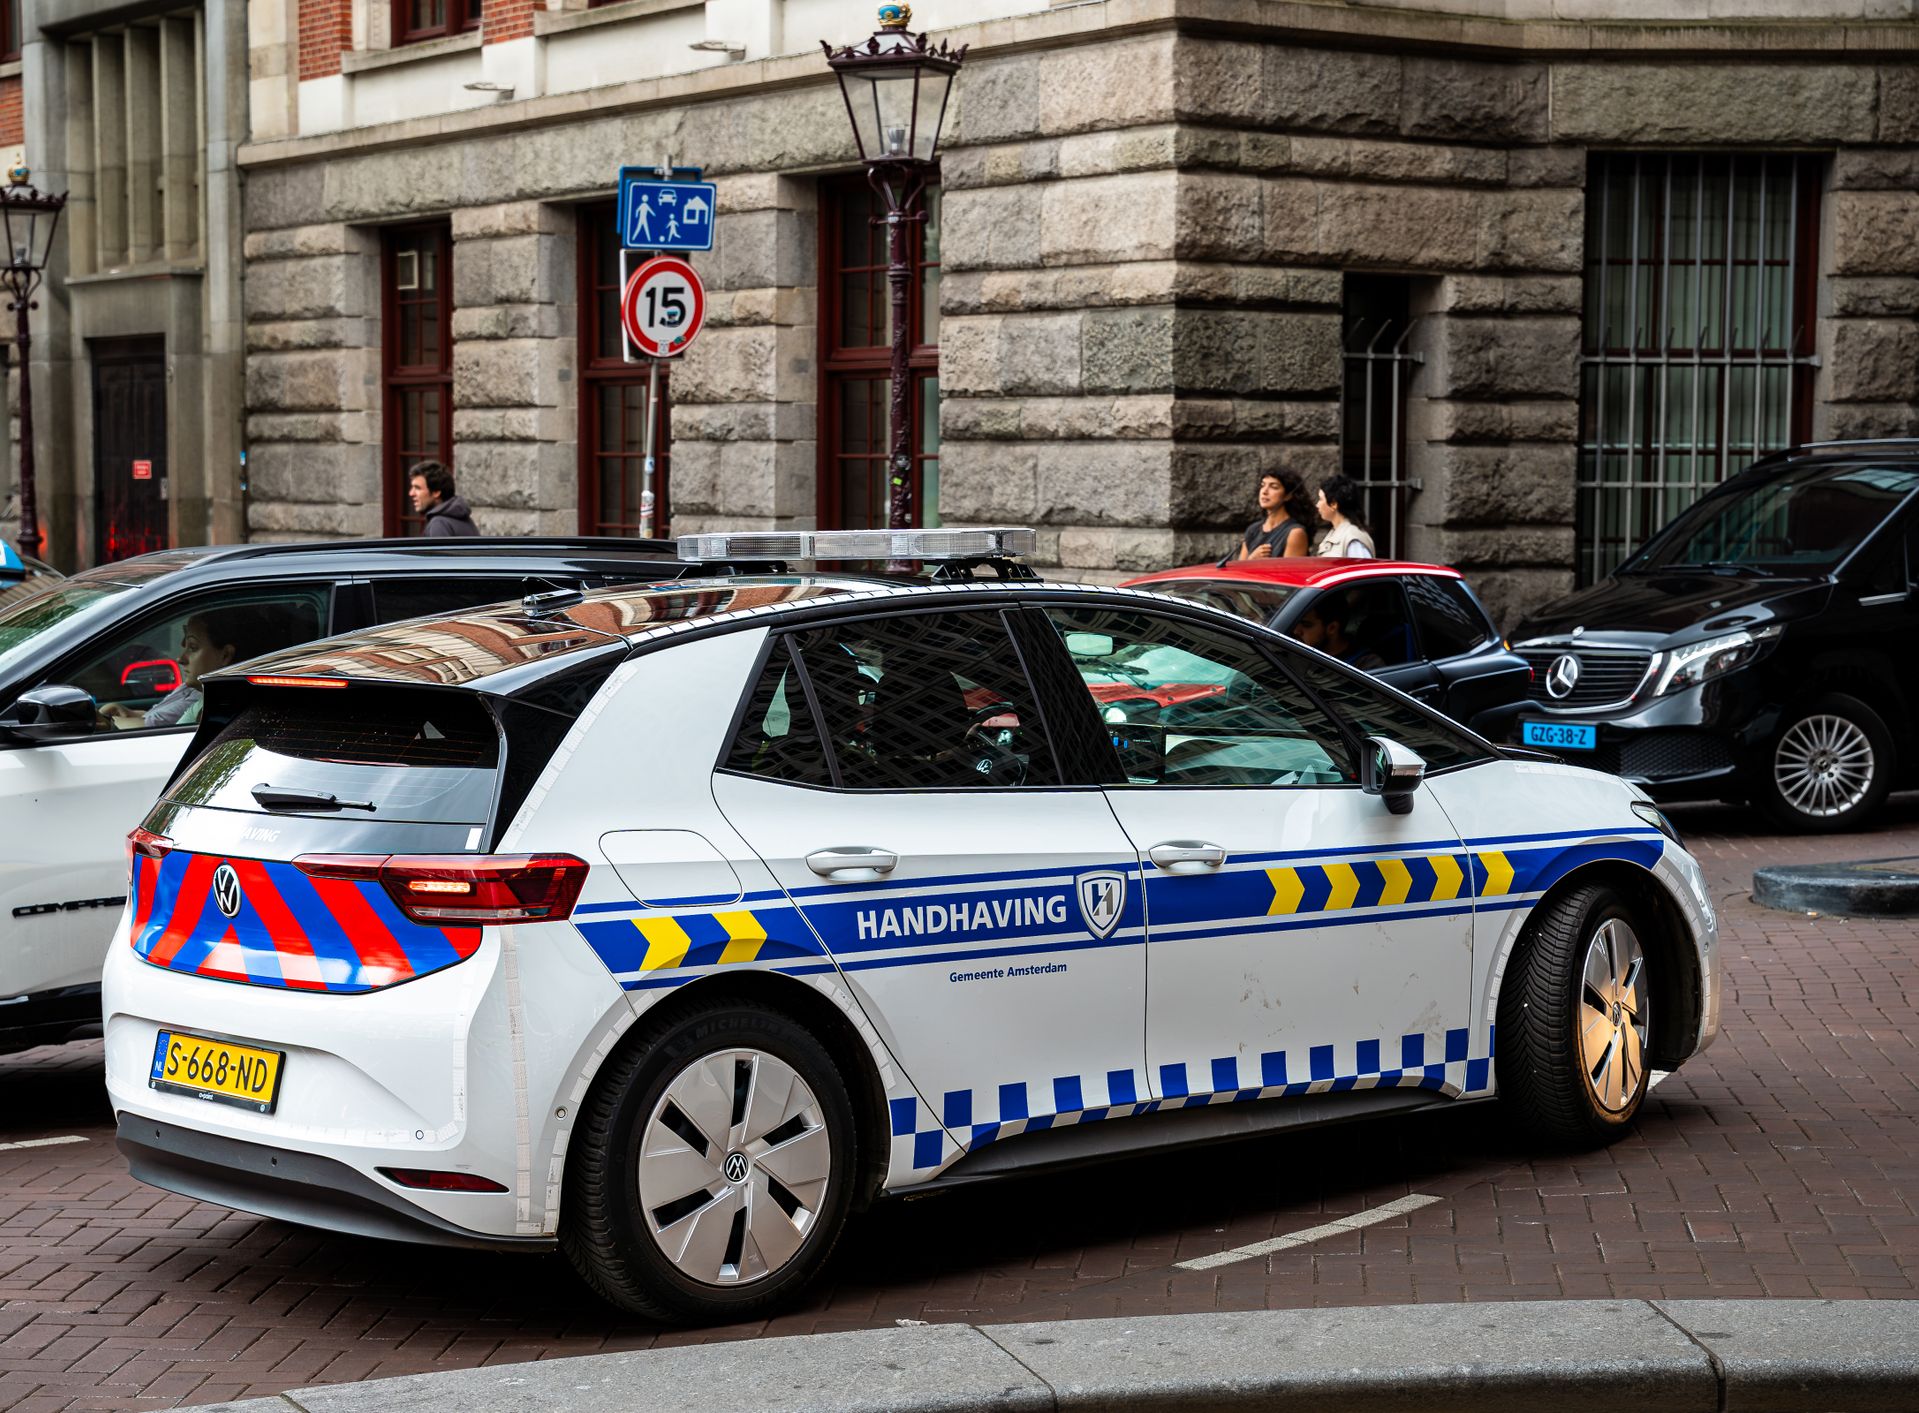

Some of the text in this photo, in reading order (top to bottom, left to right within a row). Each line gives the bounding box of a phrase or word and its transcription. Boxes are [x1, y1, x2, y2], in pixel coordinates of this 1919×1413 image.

[645, 287, 687, 328] 15
[1531, 726, 1587, 745] GZG-38-Z
[12, 896, 127, 918] COMPAS
[857, 895, 1067, 940] HANDHAVING
[950, 963, 1067, 983] Gemeente Amsterdam
[695, 1017, 780, 1039] MICHELIN
[154, 1060, 163, 1072] NL
[167, 1042, 268, 1093] S-668-ND
